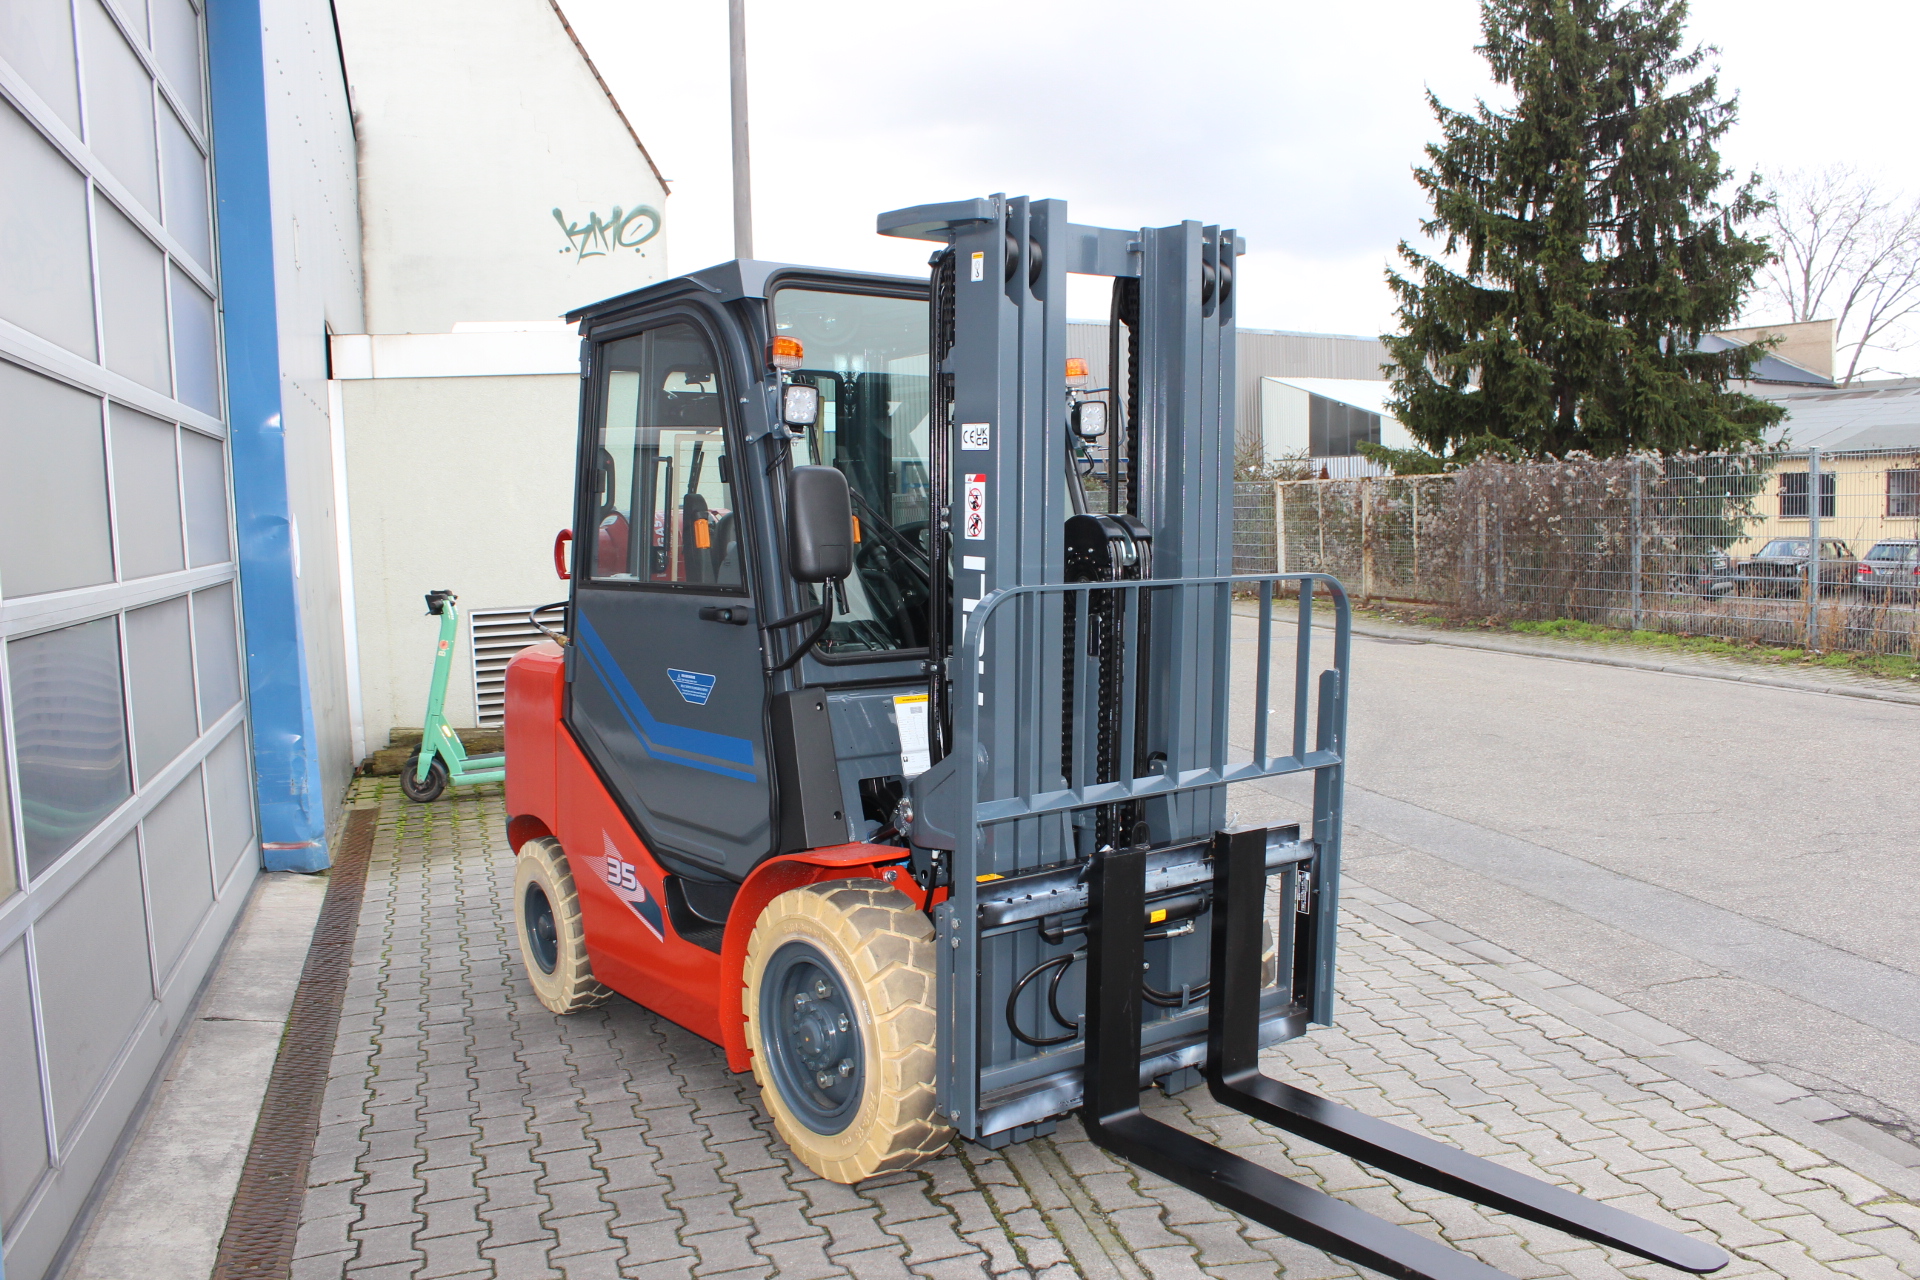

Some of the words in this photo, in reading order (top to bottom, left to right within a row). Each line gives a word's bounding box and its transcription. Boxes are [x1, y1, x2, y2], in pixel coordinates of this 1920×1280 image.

[963, 430, 975, 443] CE
[976, 427, 988, 436] UK
[976, 437, 988, 446] CA
[607, 856, 637, 891] 35
